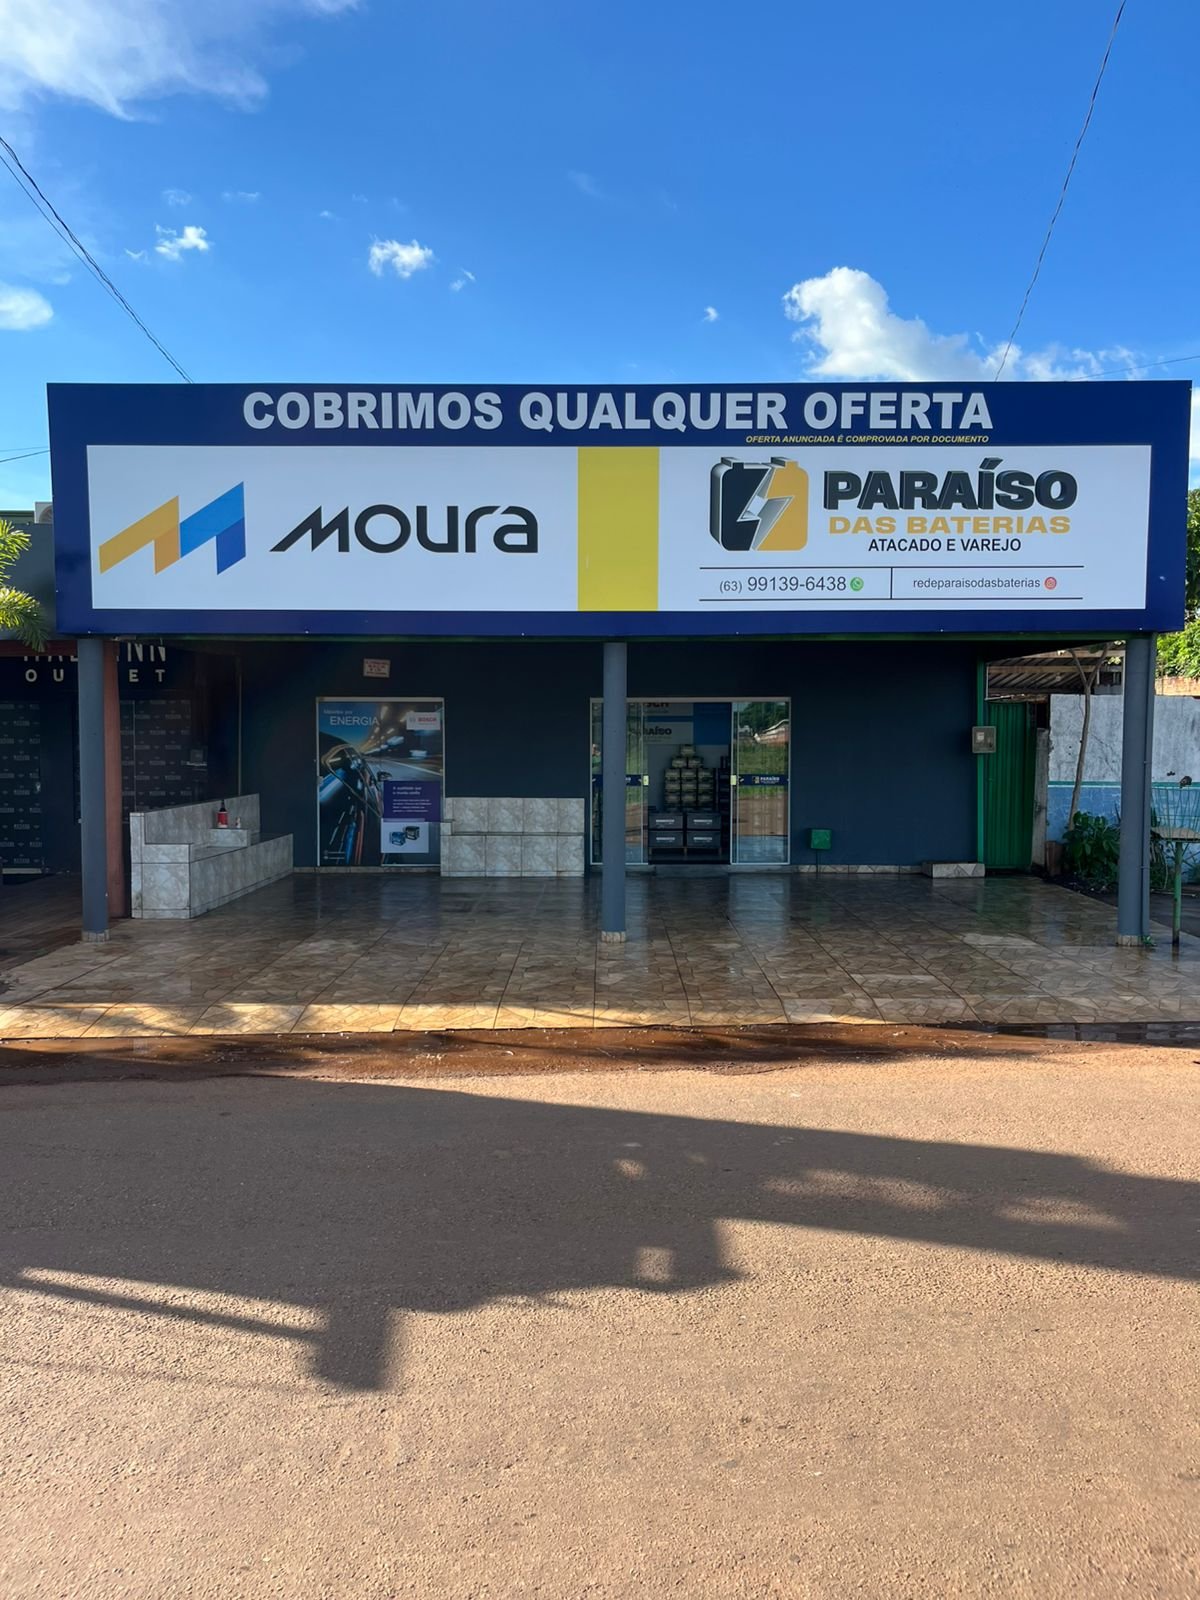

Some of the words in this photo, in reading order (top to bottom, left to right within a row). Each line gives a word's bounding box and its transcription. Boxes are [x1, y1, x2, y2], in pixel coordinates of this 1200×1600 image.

[242, 391, 503, 430] COBRIMOS
[519, 391, 789, 433] QUALQUER
[803, 391, 994, 430] OFERTA
[745, 435, 781, 443] OFERTA
[782, 435, 836, 443] ANUNCIADA
[837, 433, 845, 443] É
[845, 435, 909, 443] COMPROVADA
[910, 435, 930, 443] POR
[931, 435, 990, 443] DOCUMENTO
[823, 457, 1078, 511] PARAÍSO
[829, 516, 898, 534] DAS
[907, 516, 1071, 534] BATERIAS
[867, 538, 943, 552] ATACADO
[946, 538, 957, 552] E
[959, 537, 1022, 552] VAREJO
[719, 579, 743, 593] (63)
[747, 575, 847, 592] 99139-6438
[913, 577, 1041, 591] redeparaisodasbaterias
[25, 668, 166, 683] OUET
[329, 715, 380, 726] ENERGIA
